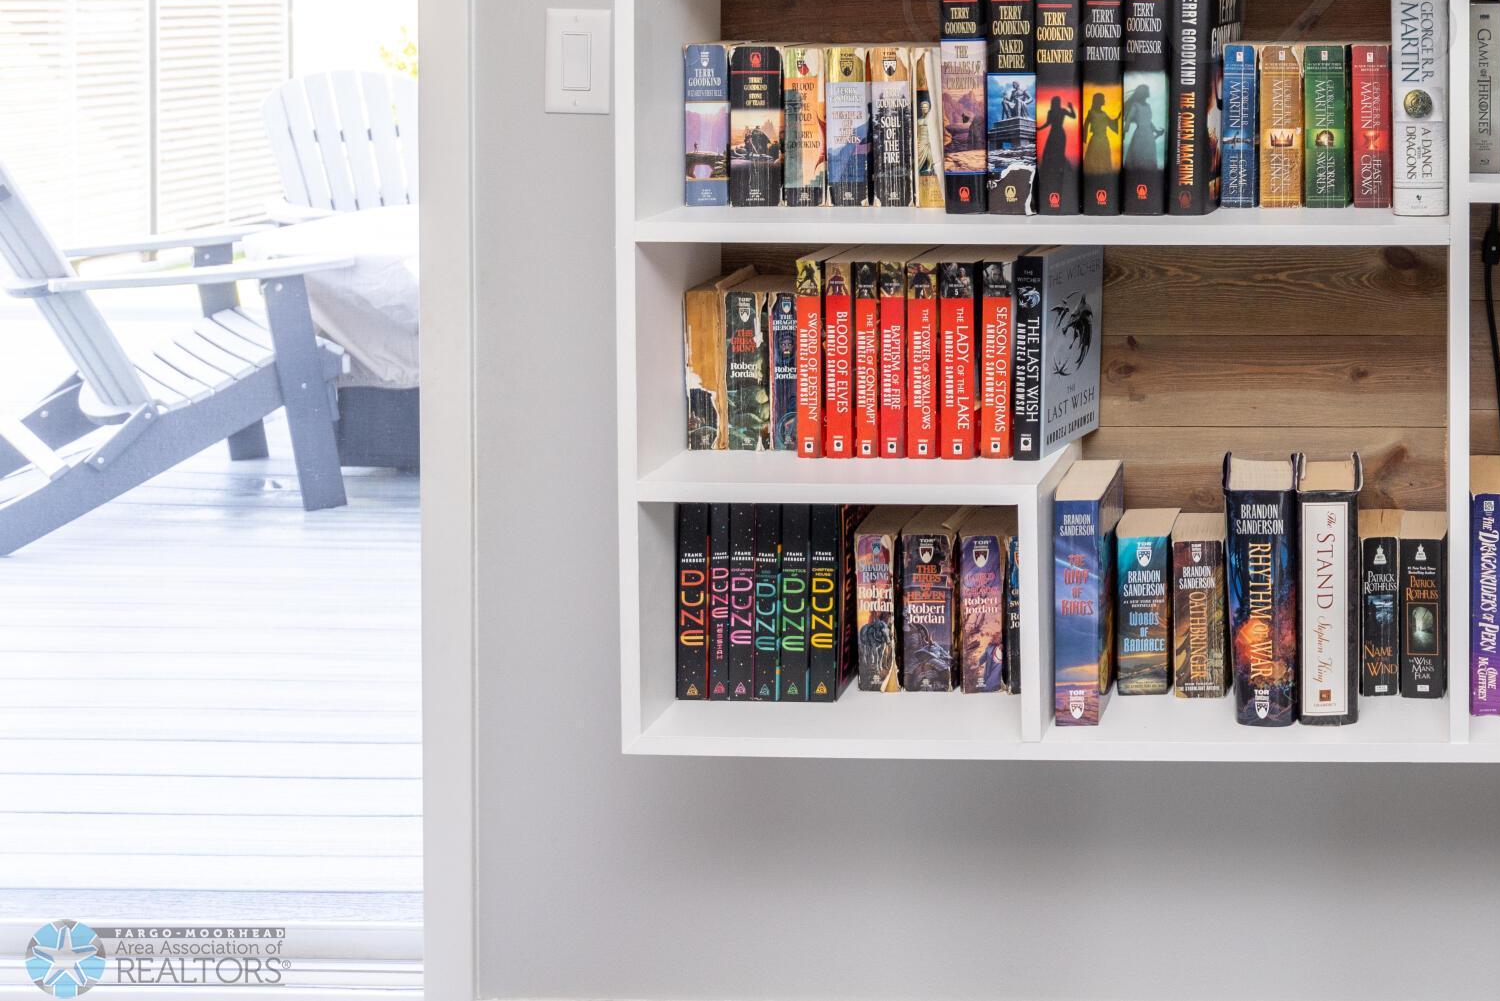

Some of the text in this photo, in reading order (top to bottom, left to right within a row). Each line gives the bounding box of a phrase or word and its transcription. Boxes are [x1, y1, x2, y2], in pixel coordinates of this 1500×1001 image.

[951, 8, 969, 19] TERRY
[999, 6, 1022, 19] TERRY
[1044, 12, 1066, 25] TERRY
[1092, 9, 1114, 22] TERRY
[945, 22, 976, 33] GOODKIND
[1086, 25, 1121, 38] GOODKIND
[1127, 18, 1162, 32] GOODKIND
[1421, 2, 1433, 55] GEORGE
[1037, 27, 1073, 40] GOODKIND
[999, 40, 1023, 53] NAKED
[1127, 41, 1161, 53] CONFESSOR
[1401, 2, 1419, 82] MARTIN
[1477, 29, 1491, 67] GAME
[1037, 49, 1073, 63] CHAINFIRE
[1087, 47, 1120, 60] PHANTOM
[999, 55, 1025, 68] EMPIRE
[694, 69, 715, 77] TERRY
[688, 78, 721, 86] GOODKIND
[1229, 81, 1240, 127] MARTIN
[1315, 80, 1325, 126] MARTIN
[1477, 76, 1491, 135] THRONES
[881, 116, 900, 127] SOUL
[886, 128, 896, 139] OF
[885, 140, 899, 151] THE
[1179, 112, 1194, 185] OMEN MACHINE
[884, 152, 900, 163] FIRE
[1406, 126, 1416, 179] DRAGONS
[1422, 139, 1432, 178] DANCE
[1361, 155, 1372, 195] CROWS
[957, 326, 968, 362] LADY
[808, 313, 818, 421] SWORD OF DESTINY
[837, 312, 848, 413] BLOOD ELVES
[891, 326, 900, 409] BAPTISM FIRE
[1016, 323, 1026, 415] ANDRZEJ SAPKOWSKI
[957, 365, 964, 376] OF
[994, 307, 1007, 432] SEASON STORMS
[1026, 317, 1039, 422] THE LAST WISH
[866, 329, 875, 424] TIME CONTEMPT
[922, 324, 930, 429] TOWER SWALLOWS
[800, 364, 808, 405] SAPKOWSKI
[913, 367, 921, 407] SAPKOWSKI
[1072, 386, 1095, 410] WISH
[958, 397, 969, 430] LAKE
[1241, 505, 1278, 518] BRANDON
[1063, 515, 1090, 525] BRANDON
[1060, 525, 1094, 536] SANDERSON
[1236, 520, 1283, 535] SANDERSON
[863, 572, 889, 581] RISING
[1128, 571, 1160, 583] BRANDON
[1183, 566, 1211, 577] BRANDON
[1368, 571, 1394, 582] PATRICK
[912, 575, 941, 583] FIRES
[1179, 578, 1215, 588] SANDERSON
[712, 568, 729, 618] DUNE
[1124, 584, 1164, 596] SANDERSON
[1365, 582, 1396, 594] ROTHFUSS
[1479, 530, 1499, 653] DRAGONRIDERS PERN
[964, 597, 997, 605] Robert
[1313, 512, 1336, 682] The STAND Stephen King
[858, 600, 893, 612] Jordan
[908, 604, 945, 614] Robert
[1061, 601, 1093, 616] KINGS
[1250, 543, 1272, 678] RHYTHM WAR
[782, 578, 805, 651] DUNE
[908, 613, 945, 624] Jordan
[1189, 592, 1207, 679] OATHBRINGER
[1367, 663, 1397, 676] WIND
